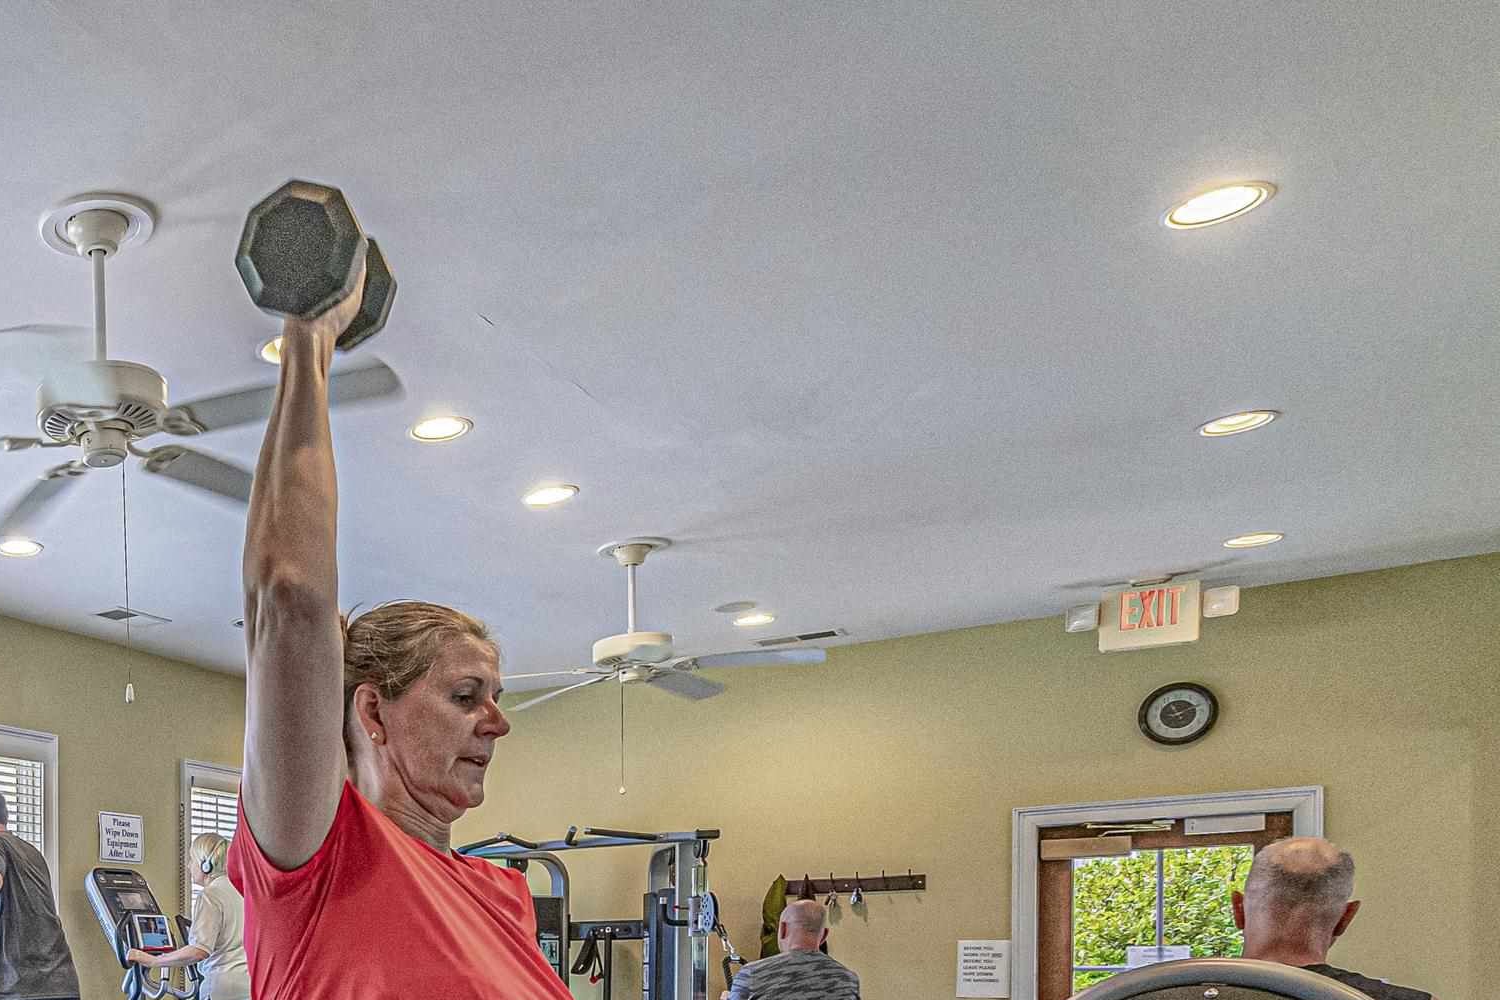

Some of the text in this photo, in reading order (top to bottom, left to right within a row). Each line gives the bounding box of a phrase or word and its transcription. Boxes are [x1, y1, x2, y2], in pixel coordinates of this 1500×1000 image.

[1119, 587, 1186, 632] EXIT
[112, 818, 131, 828] Please
[105, 828, 139, 839] Wipe Down
[107, 838, 138, 850] Equipment
[108, 848, 136, 859] After Use
